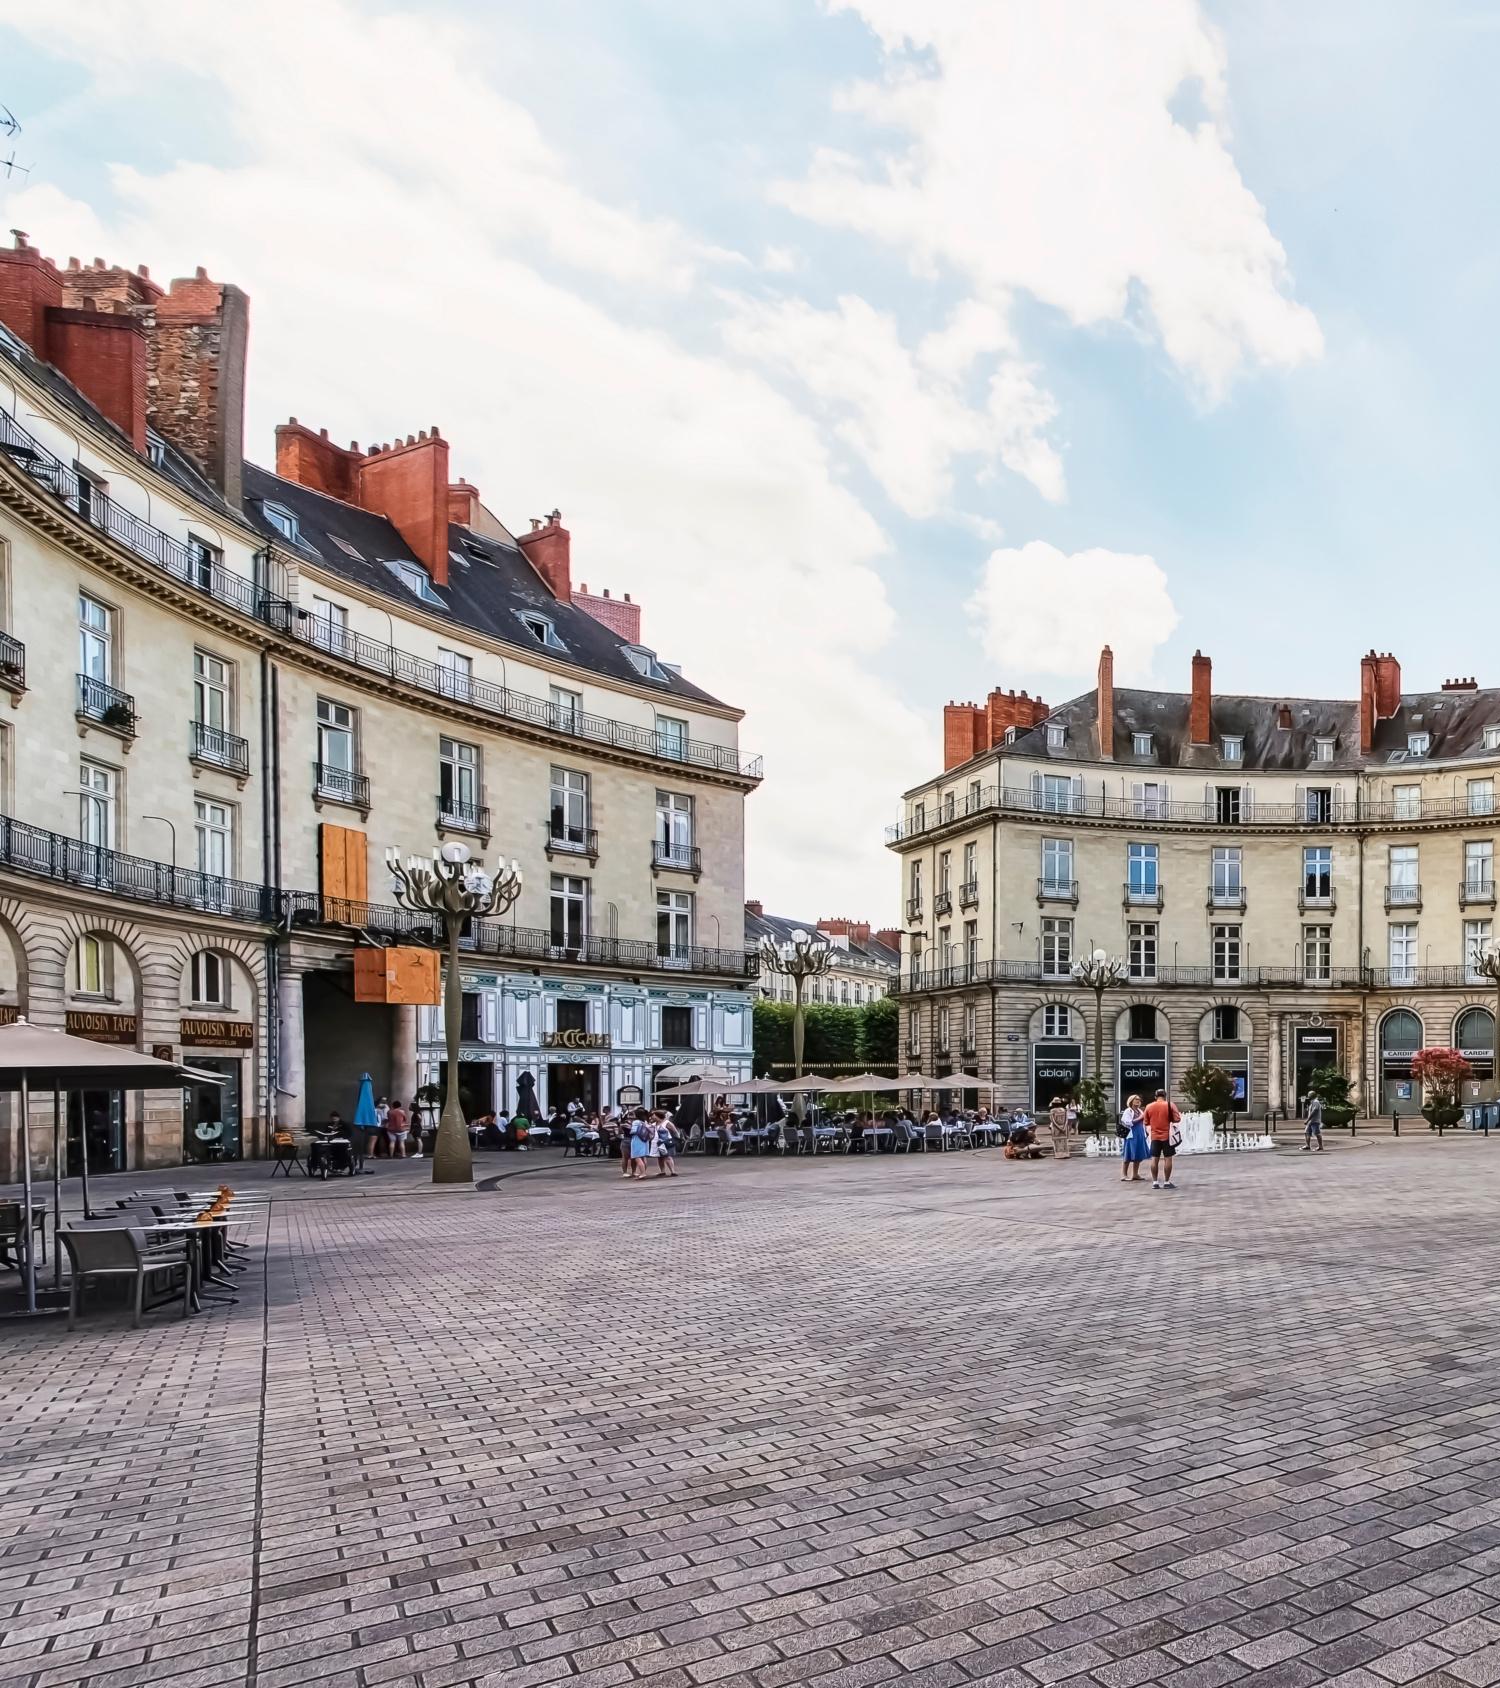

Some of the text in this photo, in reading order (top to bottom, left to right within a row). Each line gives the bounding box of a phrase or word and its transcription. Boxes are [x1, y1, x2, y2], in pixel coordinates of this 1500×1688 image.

[67, 1013, 109, 1029] AUVOISIN
[230, 1023, 252, 1038] TAPIS
[1039, 1068, 1072, 1078] ablain
[1125, 1068, 1157, 1078] ablain
